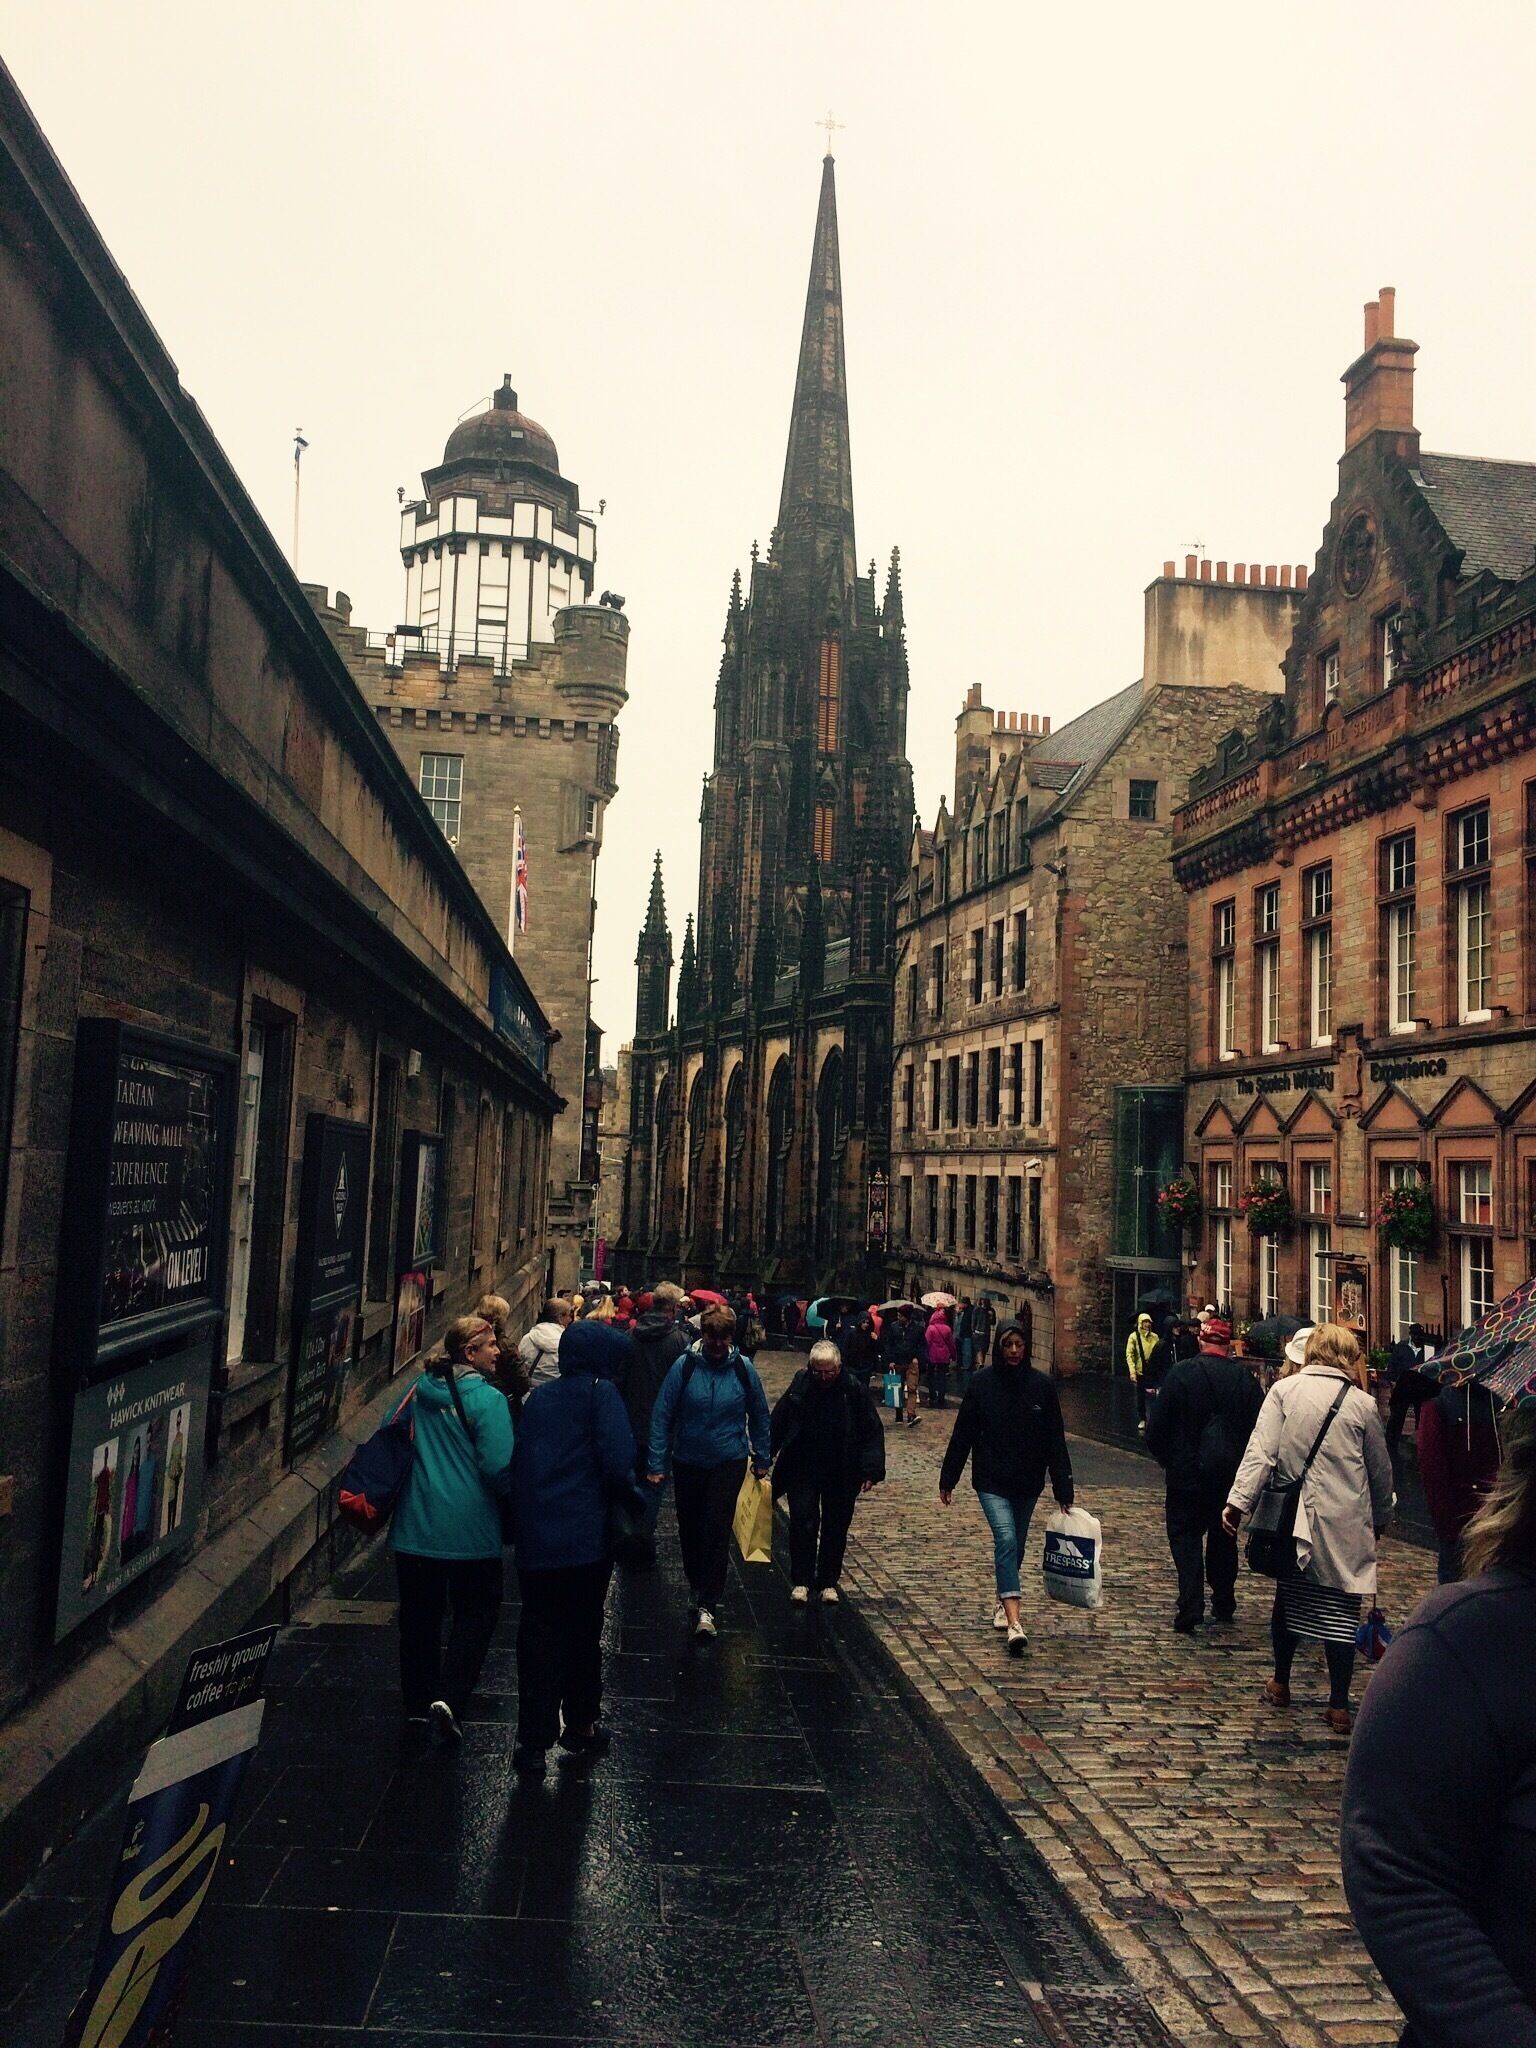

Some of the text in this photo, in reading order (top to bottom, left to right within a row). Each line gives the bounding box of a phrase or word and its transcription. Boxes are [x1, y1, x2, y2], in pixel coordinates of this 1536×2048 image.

[1236, 1056, 1448, 1095] The Scotch Whisky Experience
[116, 1079, 155, 1107] TARTAN
[113, 1120, 183, 1148] WEAVING MILL
[110, 1160, 169, 1186] EXPERIENCE
[141, 1195, 157, 1213] work
[166, 1250, 181, 1290] ON
[181, 1247, 202, 1287] LEVEL
[110, 1381, 185, 1430] HAWICK KNITWEAR
[1044, 1551, 1092, 1570] TRESPASS
[190, 1635, 272, 1683] freshly ground
[186, 1682, 223, 1711] coffee
